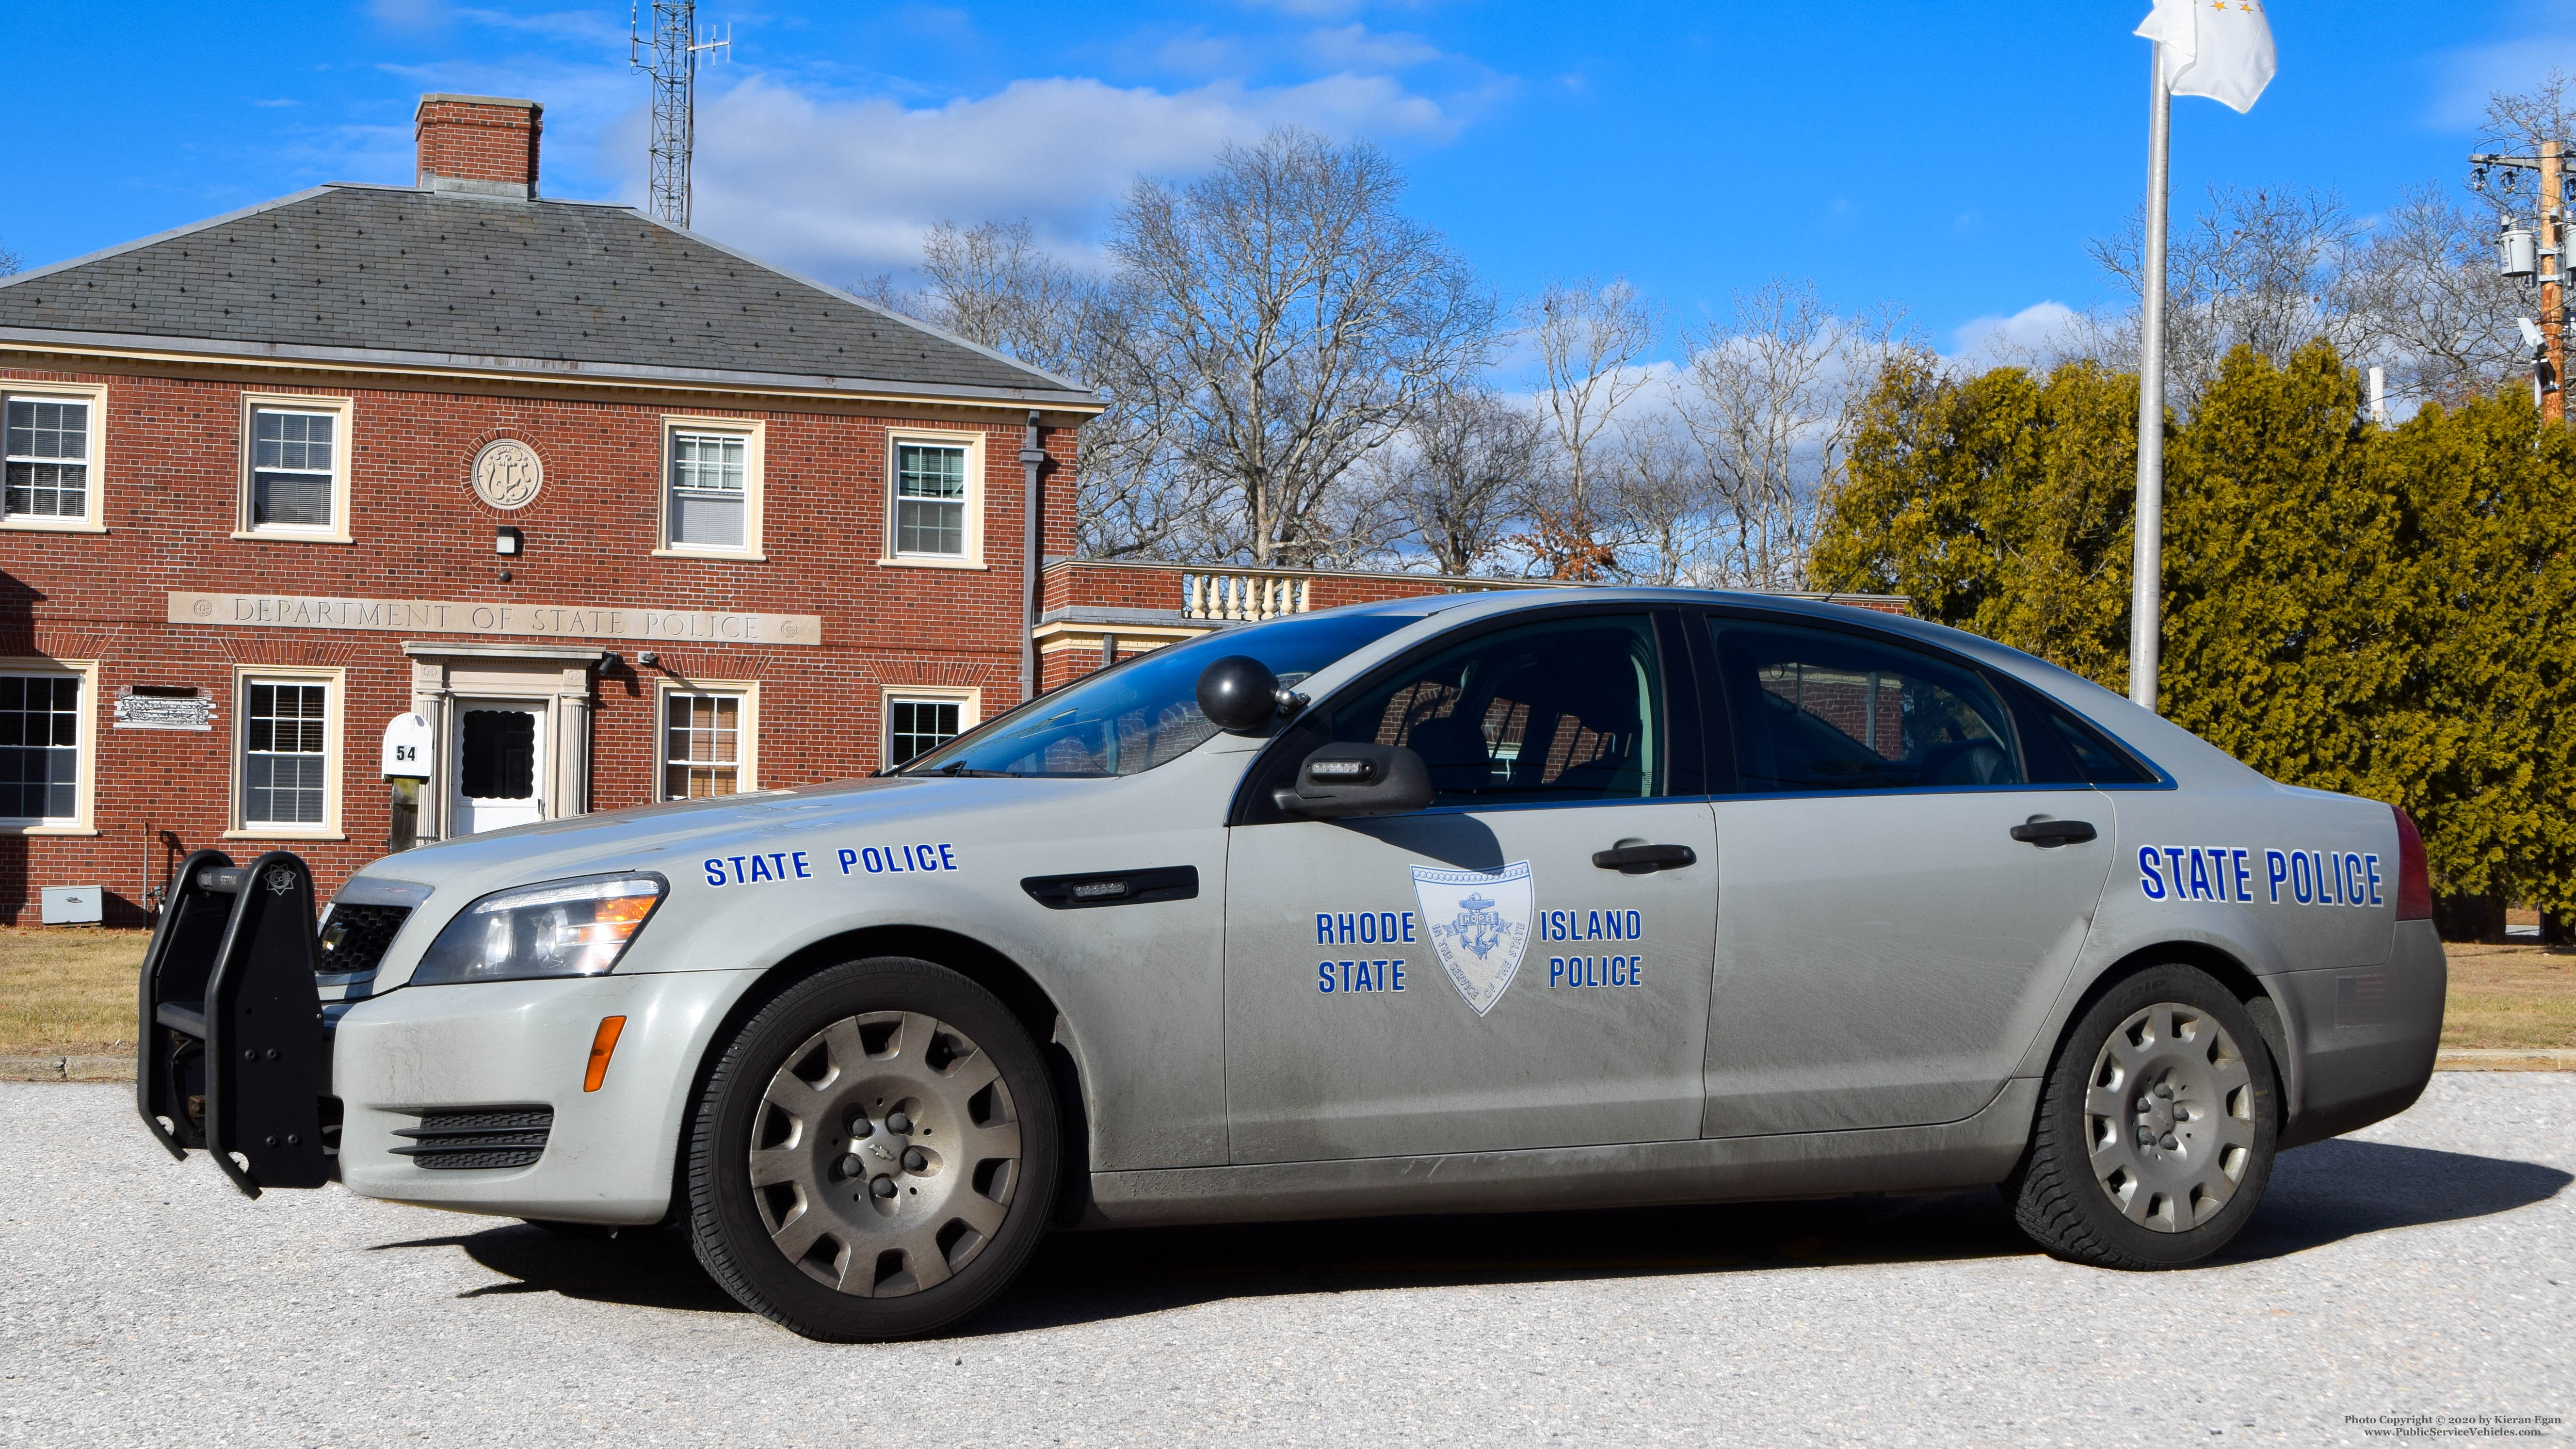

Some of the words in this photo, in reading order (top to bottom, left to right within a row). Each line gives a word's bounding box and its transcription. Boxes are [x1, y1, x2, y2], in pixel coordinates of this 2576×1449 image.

[234, 598, 451, 628] DEPARTMENT
[472, 607, 512, 630] OF
[532, 609, 625, 634] STATE
[645, 612, 759, 639] POLICE
[397, 745, 415, 761] 54
[703, 851, 813, 887] STATE
[837, 843, 959, 875] POLICE
[2137, 845, 2254, 903] STATE
[2264, 848, 2383, 907] POLICE
[1315, 911, 1416, 945] RHODE
[1540, 909, 1642, 942] ISLAND
[1465, 915, 1491, 923] HOPE
[1317, 959, 1406, 994] STATE
[1549, 955, 1642, 989] POLICE
[1432, 923, 1443, 937] IN
[1439, 940, 1453, 962] THE
[1449, 962, 1479, 999] SERVICE
[1483, 982, 1496, 999] OF
[1496, 960, 1512, 981] THE
[1510, 923, 1525, 957] STATE
